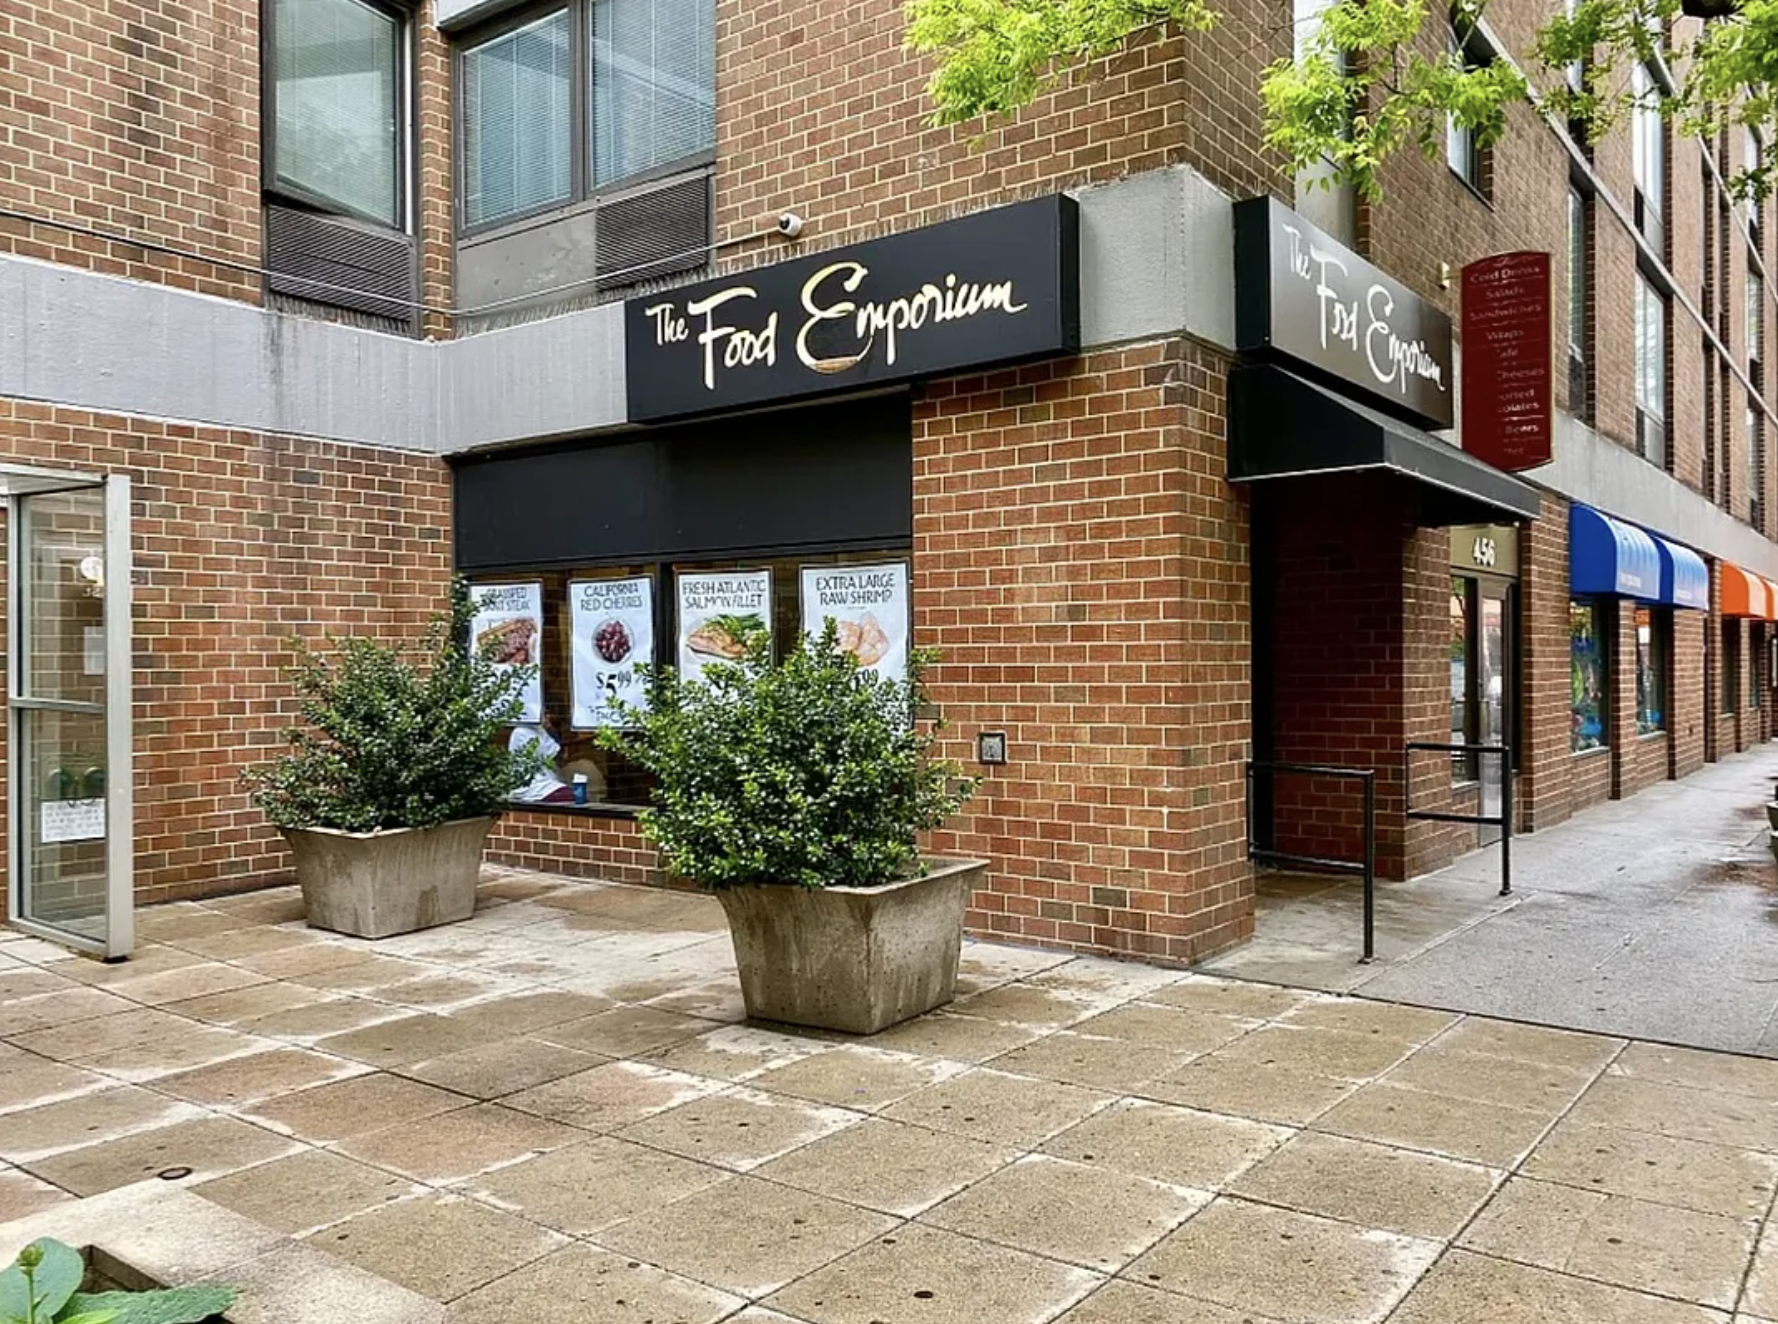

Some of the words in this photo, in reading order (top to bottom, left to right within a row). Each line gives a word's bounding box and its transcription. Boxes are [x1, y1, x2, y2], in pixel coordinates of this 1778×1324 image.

[1470, 270, 1500, 284] Cold
[1485, 286, 1525, 300] Salads
[1282, 223, 1312, 280] The
[1310, 243, 1360, 351] Food
[1365, 283, 1446, 395] Emporium
[645, 302, 689, 347] The
[687, 286, 779, 391] Food
[795, 260, 1029, 375] Emporium
[1472, 536, 1496, 567] 456
[584, 582, 639, 598] CALIFORNIA
[682, 581, 715, 596] FRESH
[717, 579, 767, 594] ATLANTIC
[815, 575, 857, 592] EXTRA
[858, 572, 896, 589] LARGE
[580, 597, 602, 612] RED
[602, 595, 643, 611] CHERRIES
[685, 595, 731, 610] SALMON
[732, 593, 763, 609] FILLET
[820, 590, 849, 606] RAW
[850, 588, 894, 605] SHRIMP
